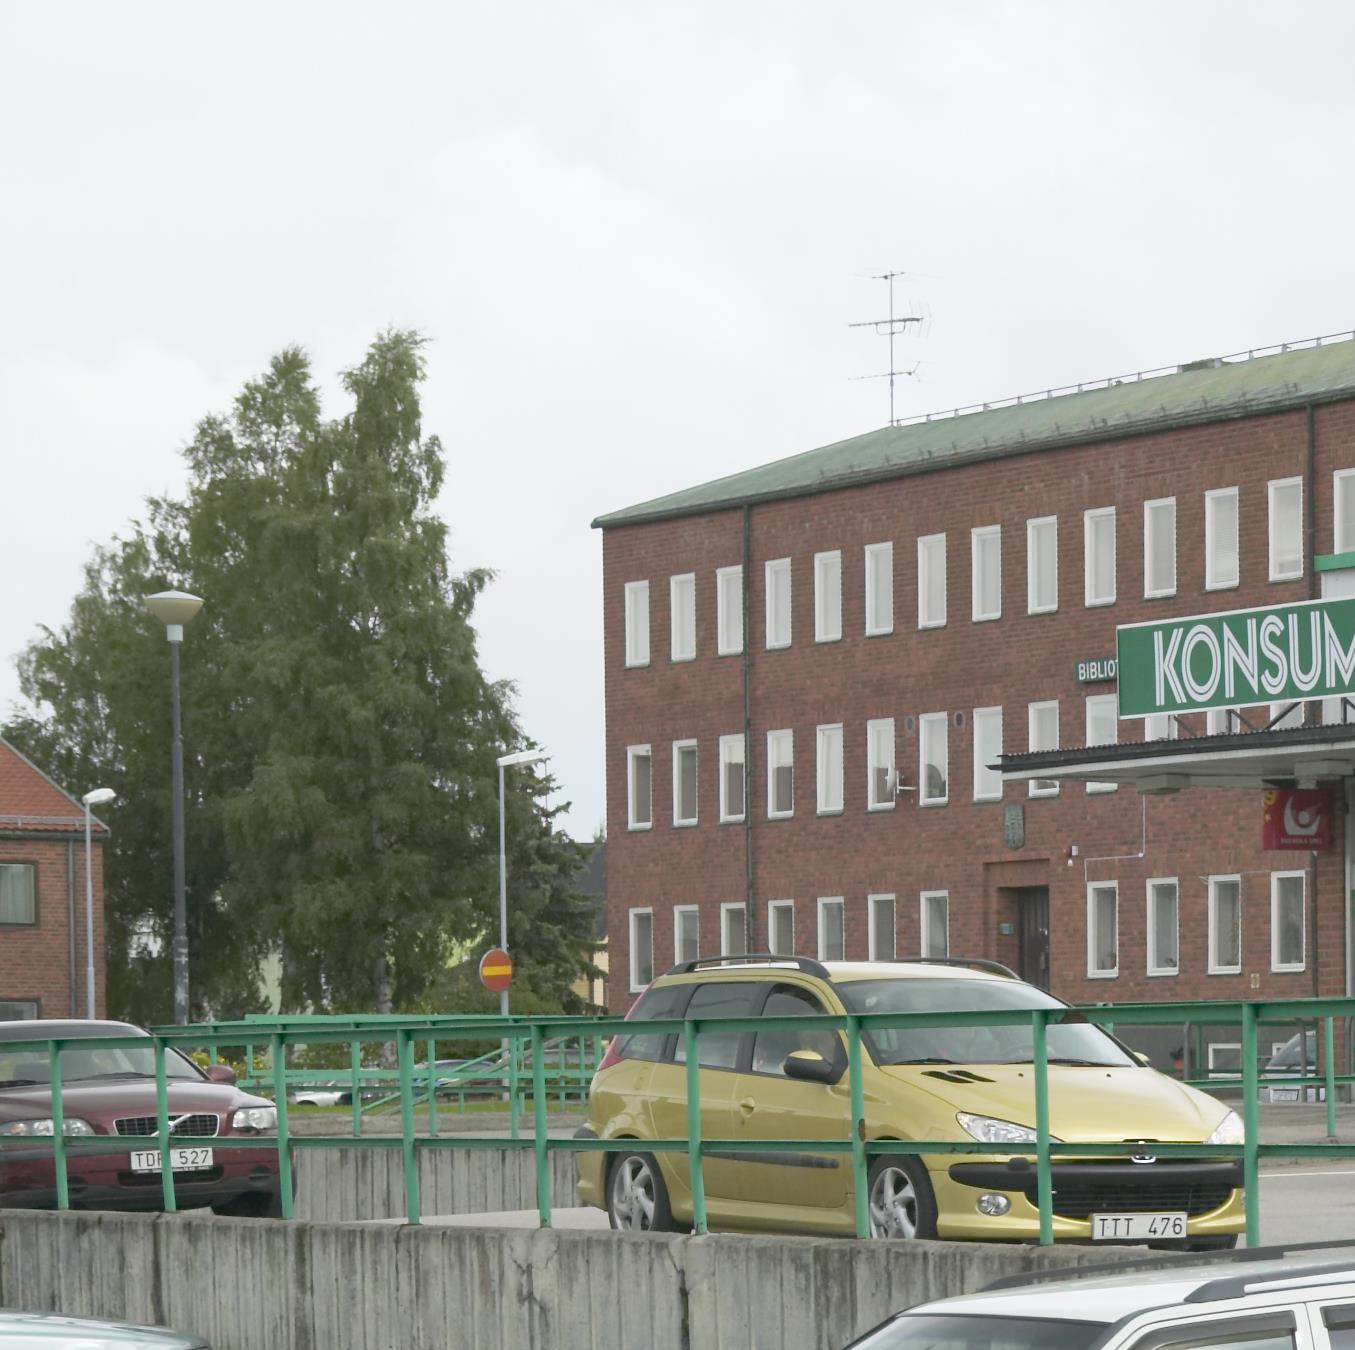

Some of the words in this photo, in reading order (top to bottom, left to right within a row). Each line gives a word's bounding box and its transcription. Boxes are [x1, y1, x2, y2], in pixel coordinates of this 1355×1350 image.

[1078, 660, 1118, 680] BIBLIO
[179, 1150, 209, 1165] 527
[1099, 1217, 1133, 1236] TTT
[1148, 1217, 1183, 1236] 476
